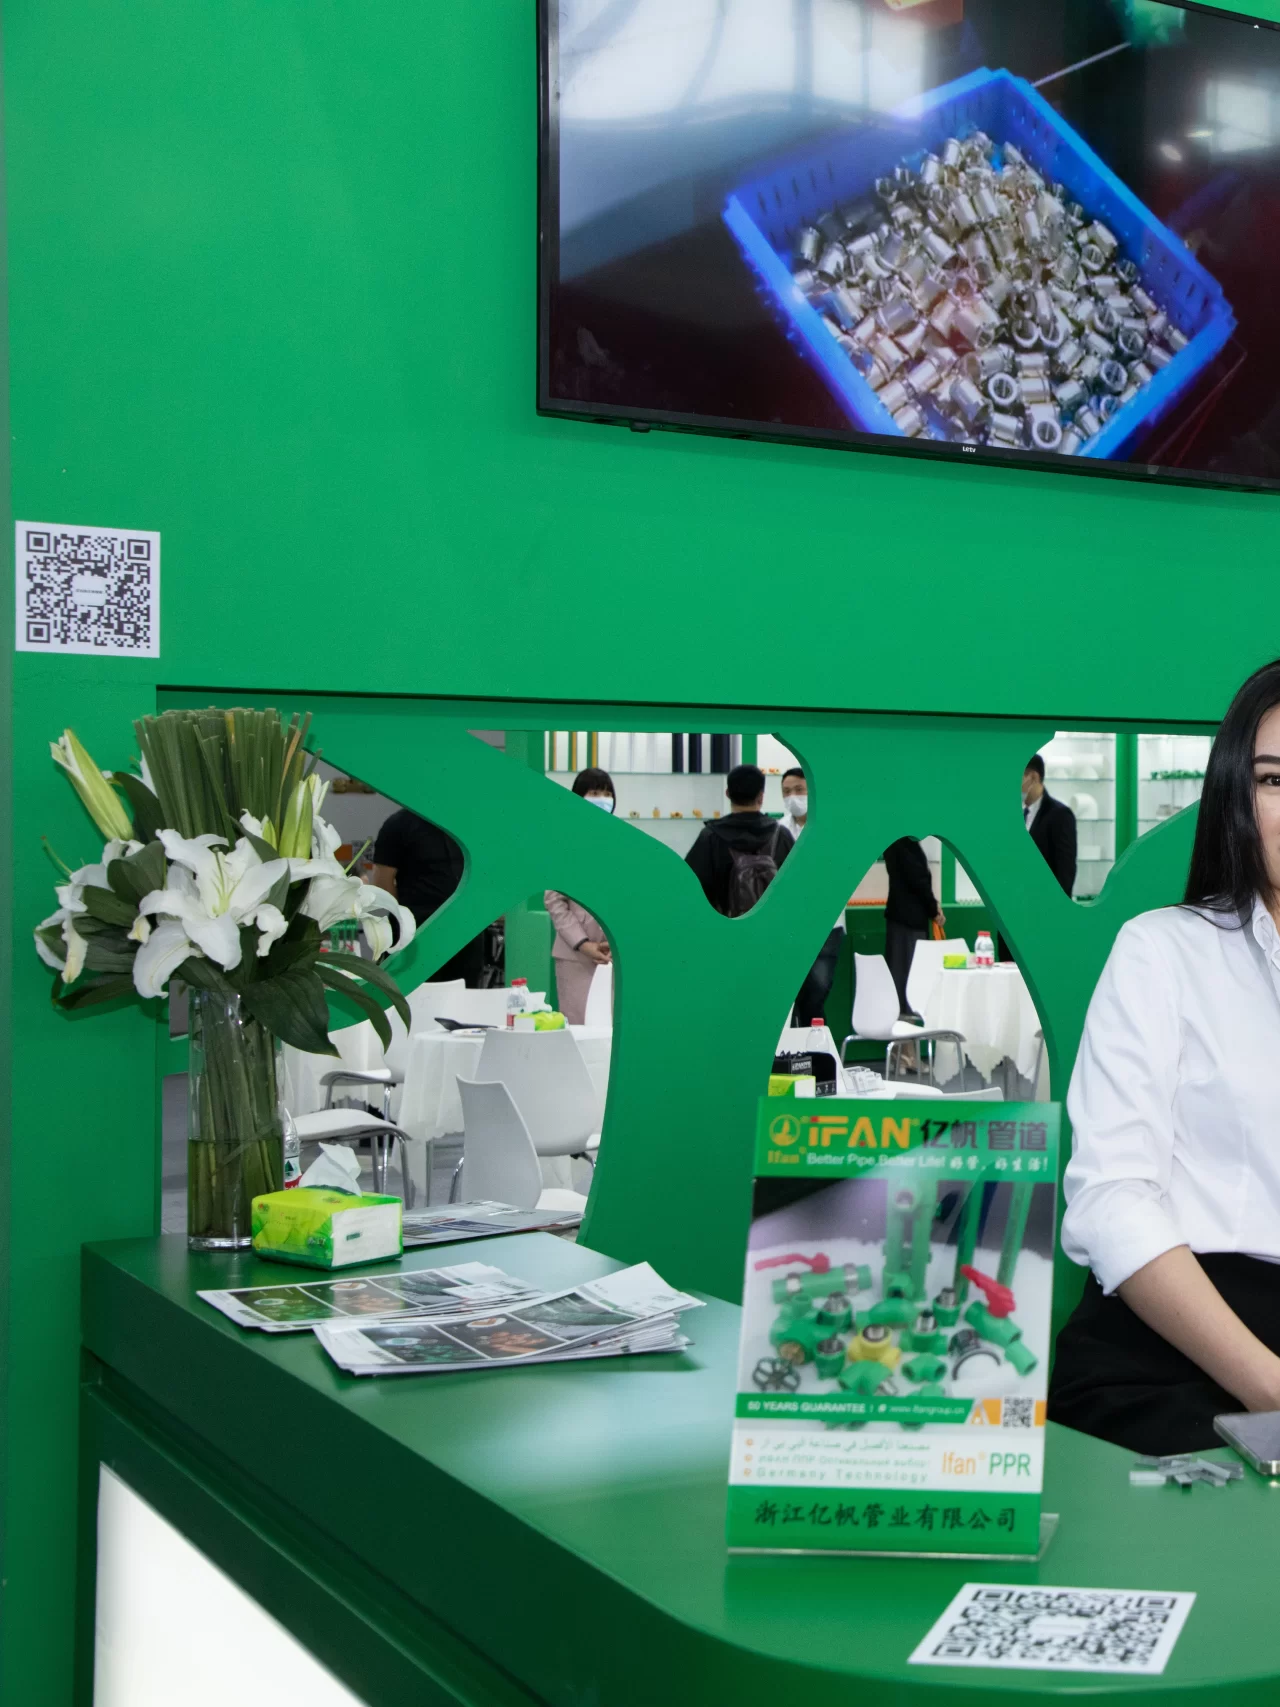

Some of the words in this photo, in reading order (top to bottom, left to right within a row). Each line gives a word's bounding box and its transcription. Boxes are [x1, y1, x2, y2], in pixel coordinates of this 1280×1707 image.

[806, 1152, 845, 1165] Better
[763, 1401, 799, 1412] YEARS
[801, 1402, 866, 1414] GUARANTEE
[989, 1453, 1031, 1477] PPR
[756, 1468, 827, 1481] Germany
[835, 1468, 928, 1484] Technology
